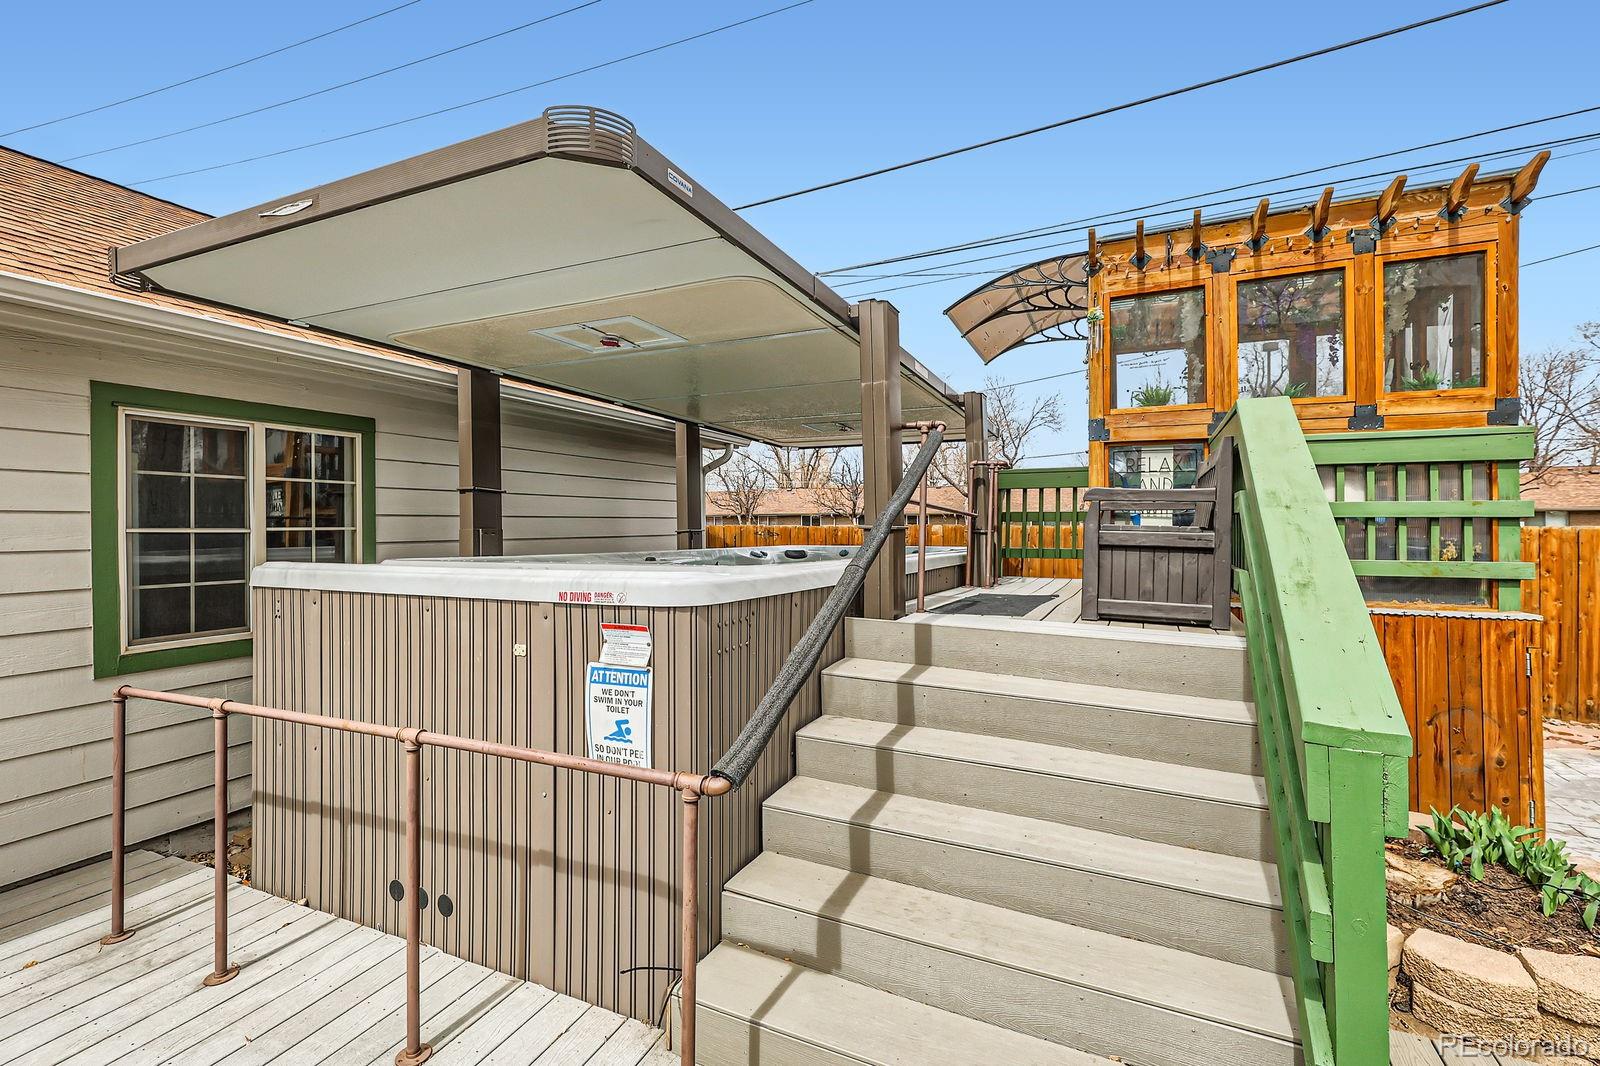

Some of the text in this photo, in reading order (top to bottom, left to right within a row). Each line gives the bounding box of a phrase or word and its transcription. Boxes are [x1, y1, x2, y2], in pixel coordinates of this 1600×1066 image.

[669, 172, 692, 193] COVANA
[1126, 456, 1183, 473] RELAX
[1140, 477, 1173, 489] AND
[558, 591, 568, 602] NO
[569, 592, 592, 603] DIVING
[591, 670, 648, 686] ATTENTION
[601, 688, 635, 698] WE DON'T
[593, 696, 614, 704] SWIM
[624, 699, 643, 707] YOUR
[606, 705, 630, 714] TOILET
[594, 743, 644, 760] SO DON'T PEE
[596, 753, 604, 762] IN
